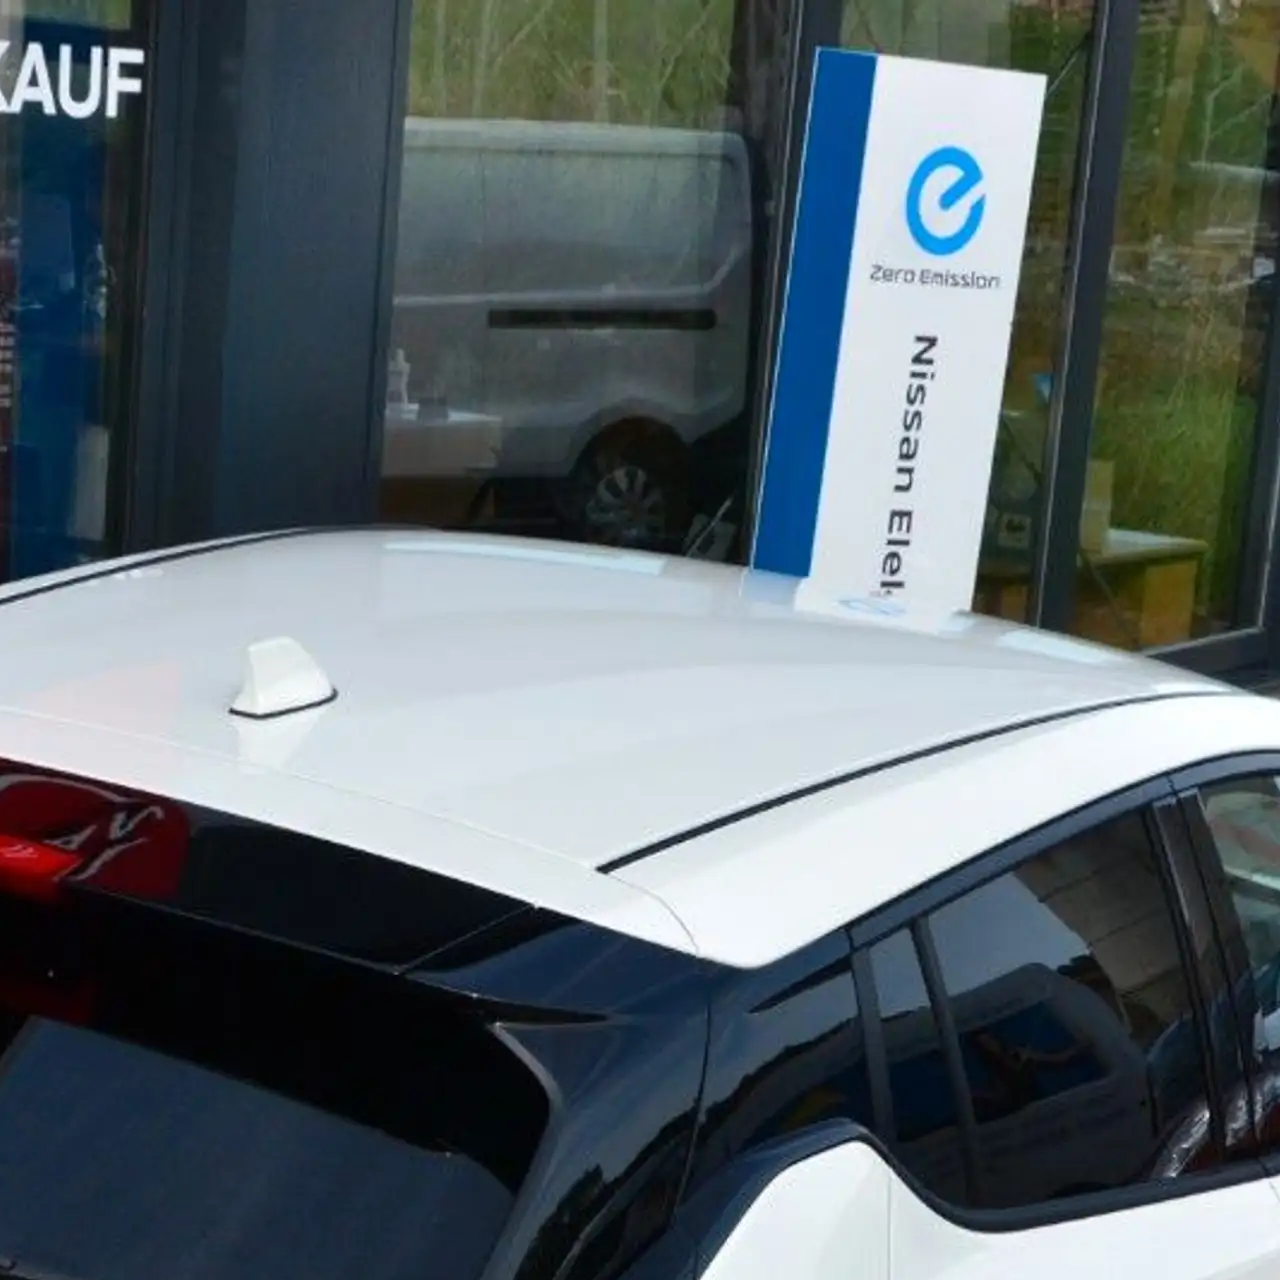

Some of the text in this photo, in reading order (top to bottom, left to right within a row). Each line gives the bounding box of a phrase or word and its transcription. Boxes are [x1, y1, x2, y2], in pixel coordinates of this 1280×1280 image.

[870, 264, 1001, 290] Zero Emission
[892, 335, 939, 494] Nissan
